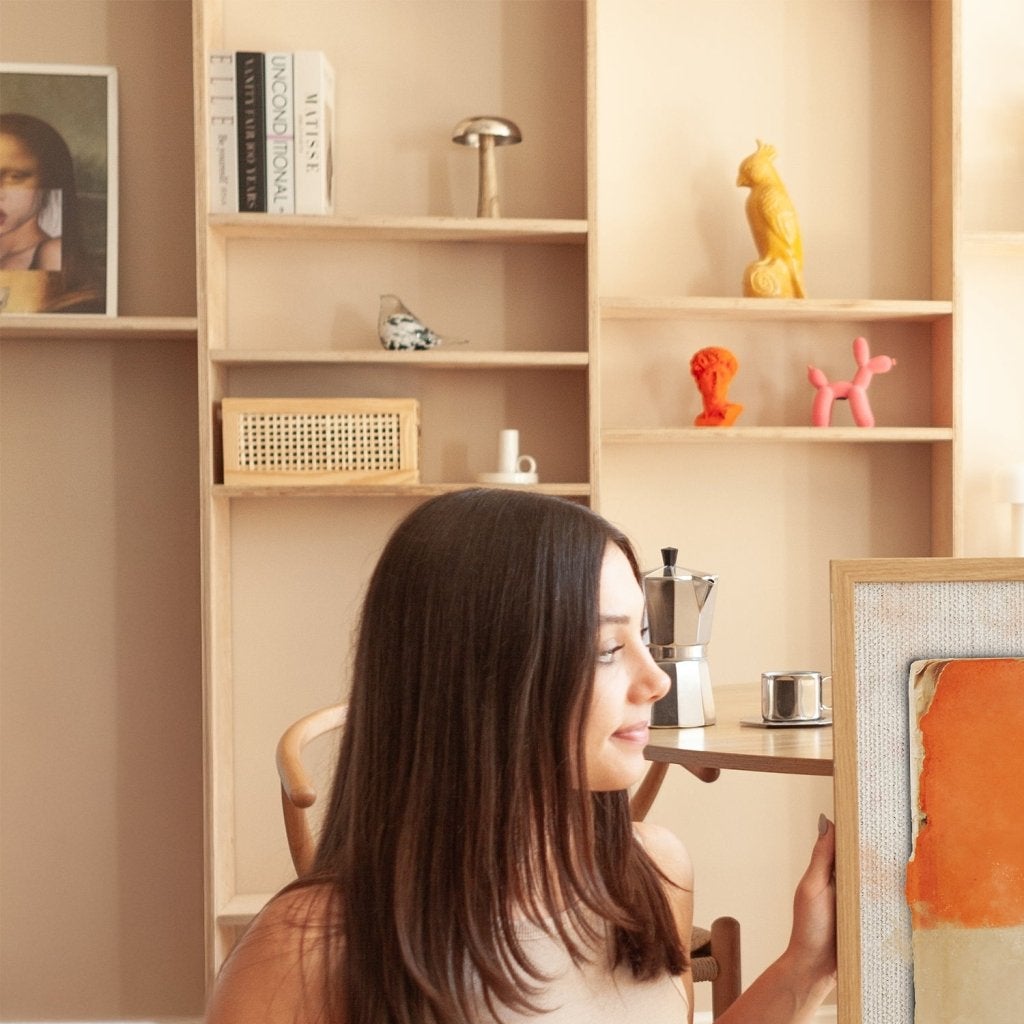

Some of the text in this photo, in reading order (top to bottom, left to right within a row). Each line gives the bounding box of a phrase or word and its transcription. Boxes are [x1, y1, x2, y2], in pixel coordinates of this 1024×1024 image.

[210, 55, 234, 125] ELLE
[244, 58, 255, 105] VANITY
[244, 109, 256, 140] FAIR
[271, 55, 288, 204] UNCONDITIONAL
[305, 93, 319, 174] MATISSE
[246, 167, 258, 209] YEARS
